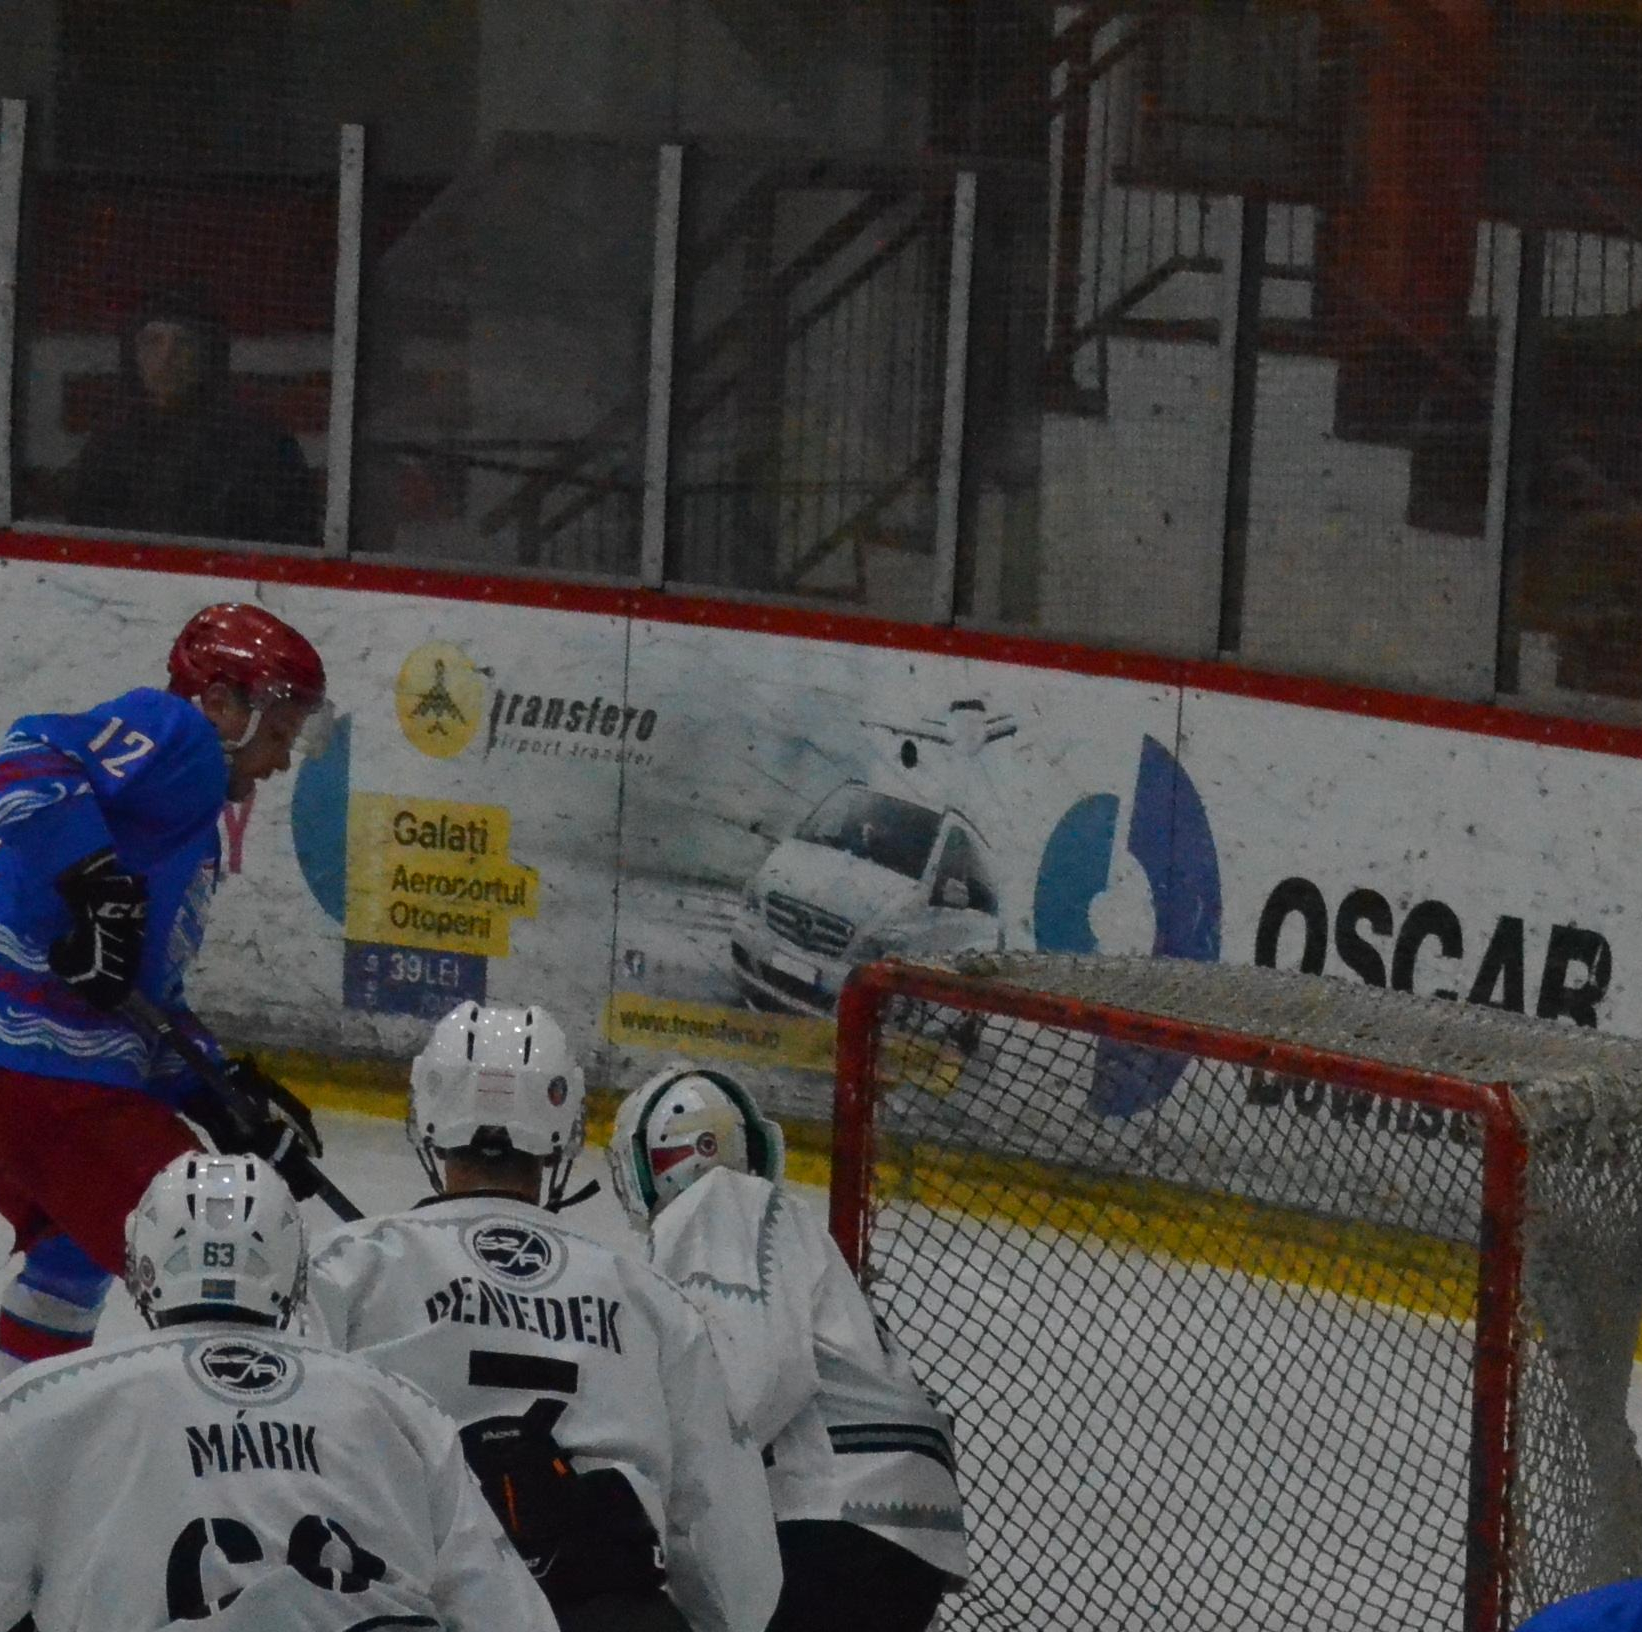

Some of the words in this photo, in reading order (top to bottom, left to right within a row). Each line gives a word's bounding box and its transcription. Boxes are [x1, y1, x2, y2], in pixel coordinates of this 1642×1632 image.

[87, 716, 155, 778] 12
[1254, 876, 1612, 1029] OSCAR
[203, 1242, 235, 1267] 63
[185, 1409, 320, 1477] MÁRK
